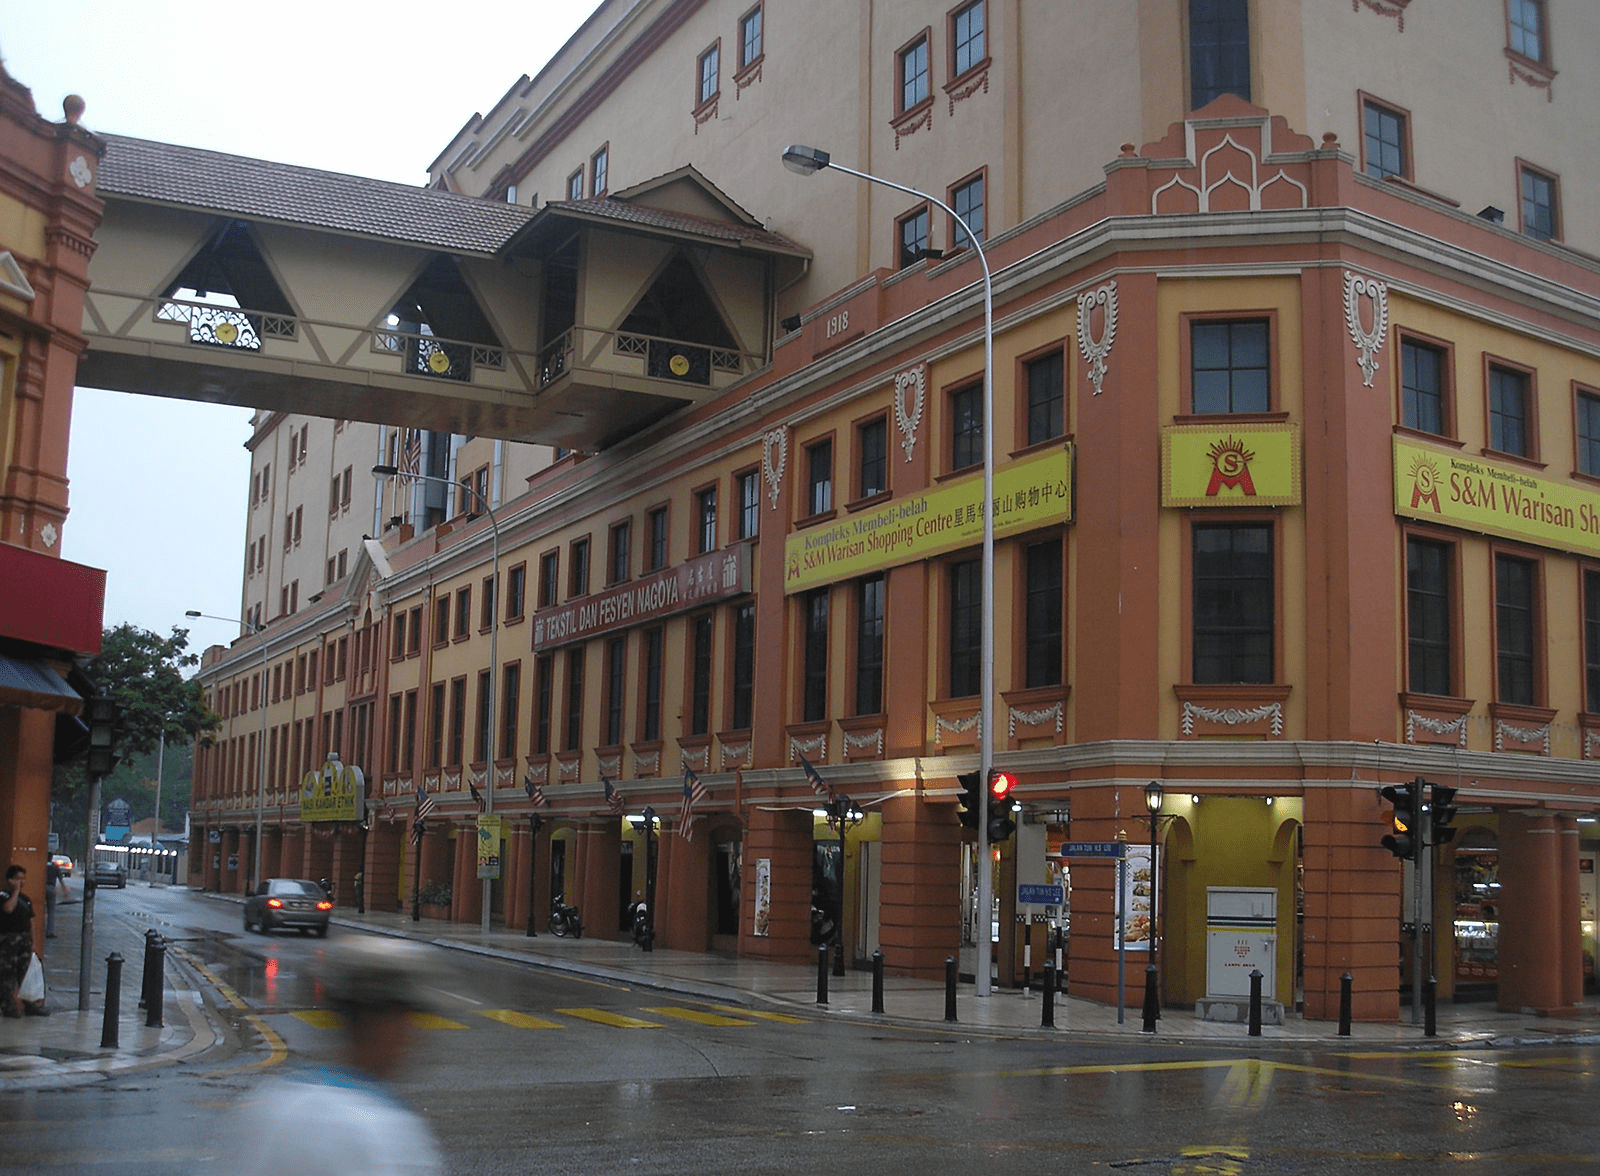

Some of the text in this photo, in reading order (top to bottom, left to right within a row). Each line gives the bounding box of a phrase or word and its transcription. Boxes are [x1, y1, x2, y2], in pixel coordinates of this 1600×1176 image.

[826, 310, 849, 339] 1918
[1450, 458, 1538, 489] Kompleks Membeli-belah
[1450, 472, 1497, 511] S&M
[1501, 484, 1575, 529] Warisan
[803, 548, 825, 570] S&M
[827, 538, 865, 562] Warisan
[867, 523, 914, 554] Shopping
[916, 513, 953, 538] Centre
[804, 525, 850, 550] Kompleks
[852, 497, 928, 535] Membeli-belah
[546, 613, 577, 641] TEKSTIL
[578, 605, 598, 632] DAN
[599, 589, 635, 625] FESYEN
[637, 575, 679, 615] NAGOYA
